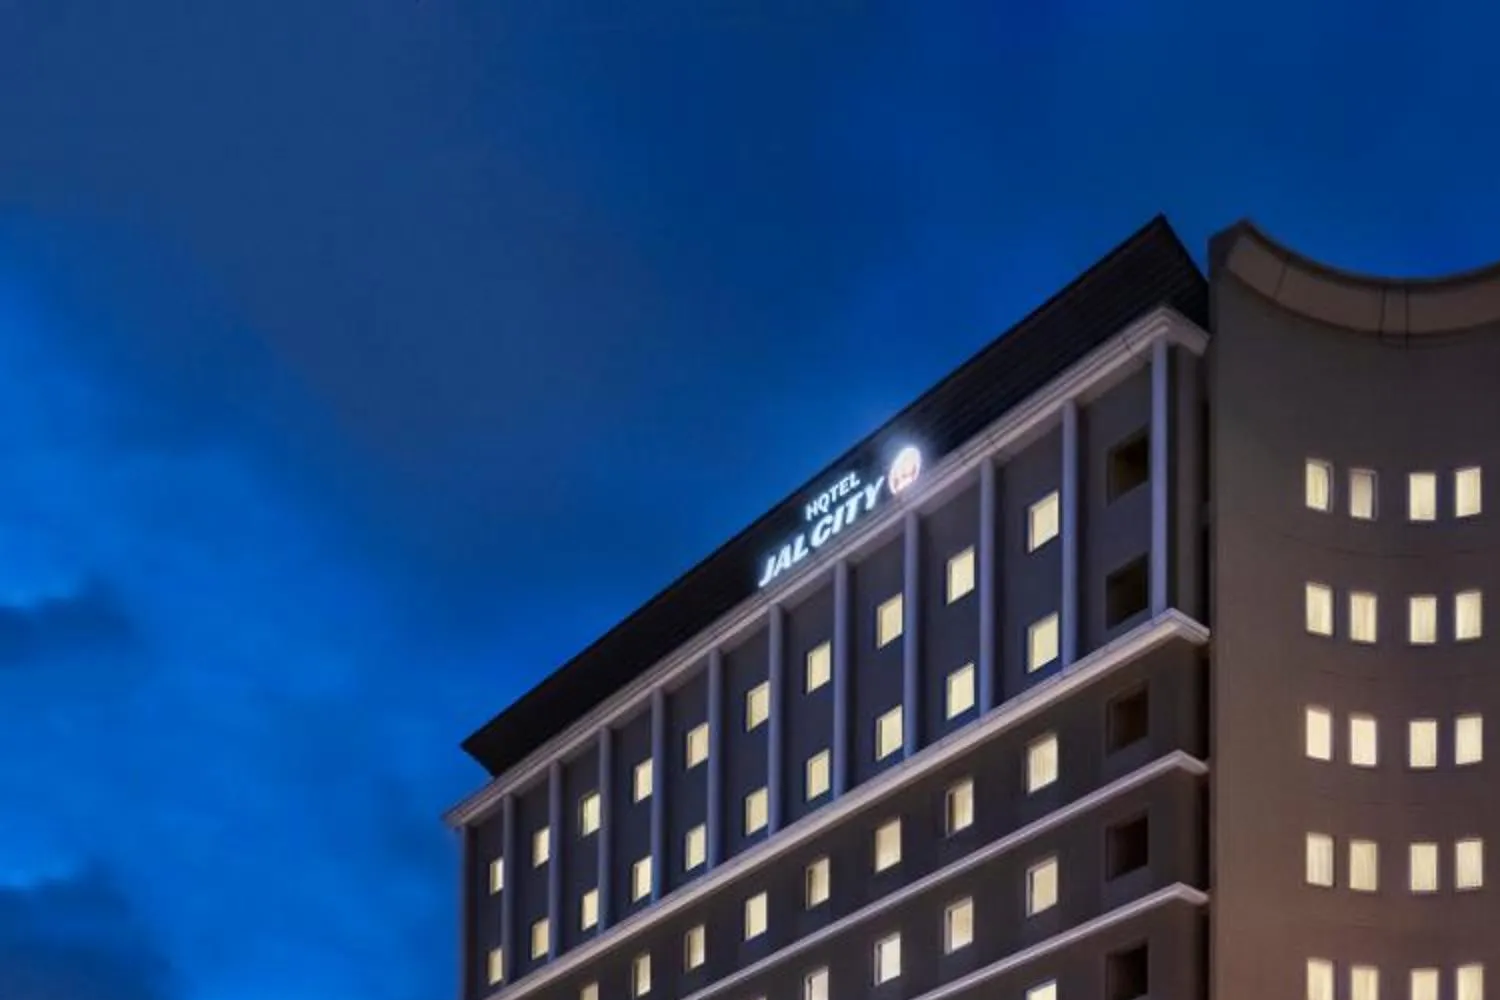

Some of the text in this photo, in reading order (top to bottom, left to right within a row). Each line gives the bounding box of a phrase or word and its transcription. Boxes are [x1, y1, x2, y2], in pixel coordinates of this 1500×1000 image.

[758, 475, 884, 588] JAL CITY
[805, 471, 860, 521] HOTEL
